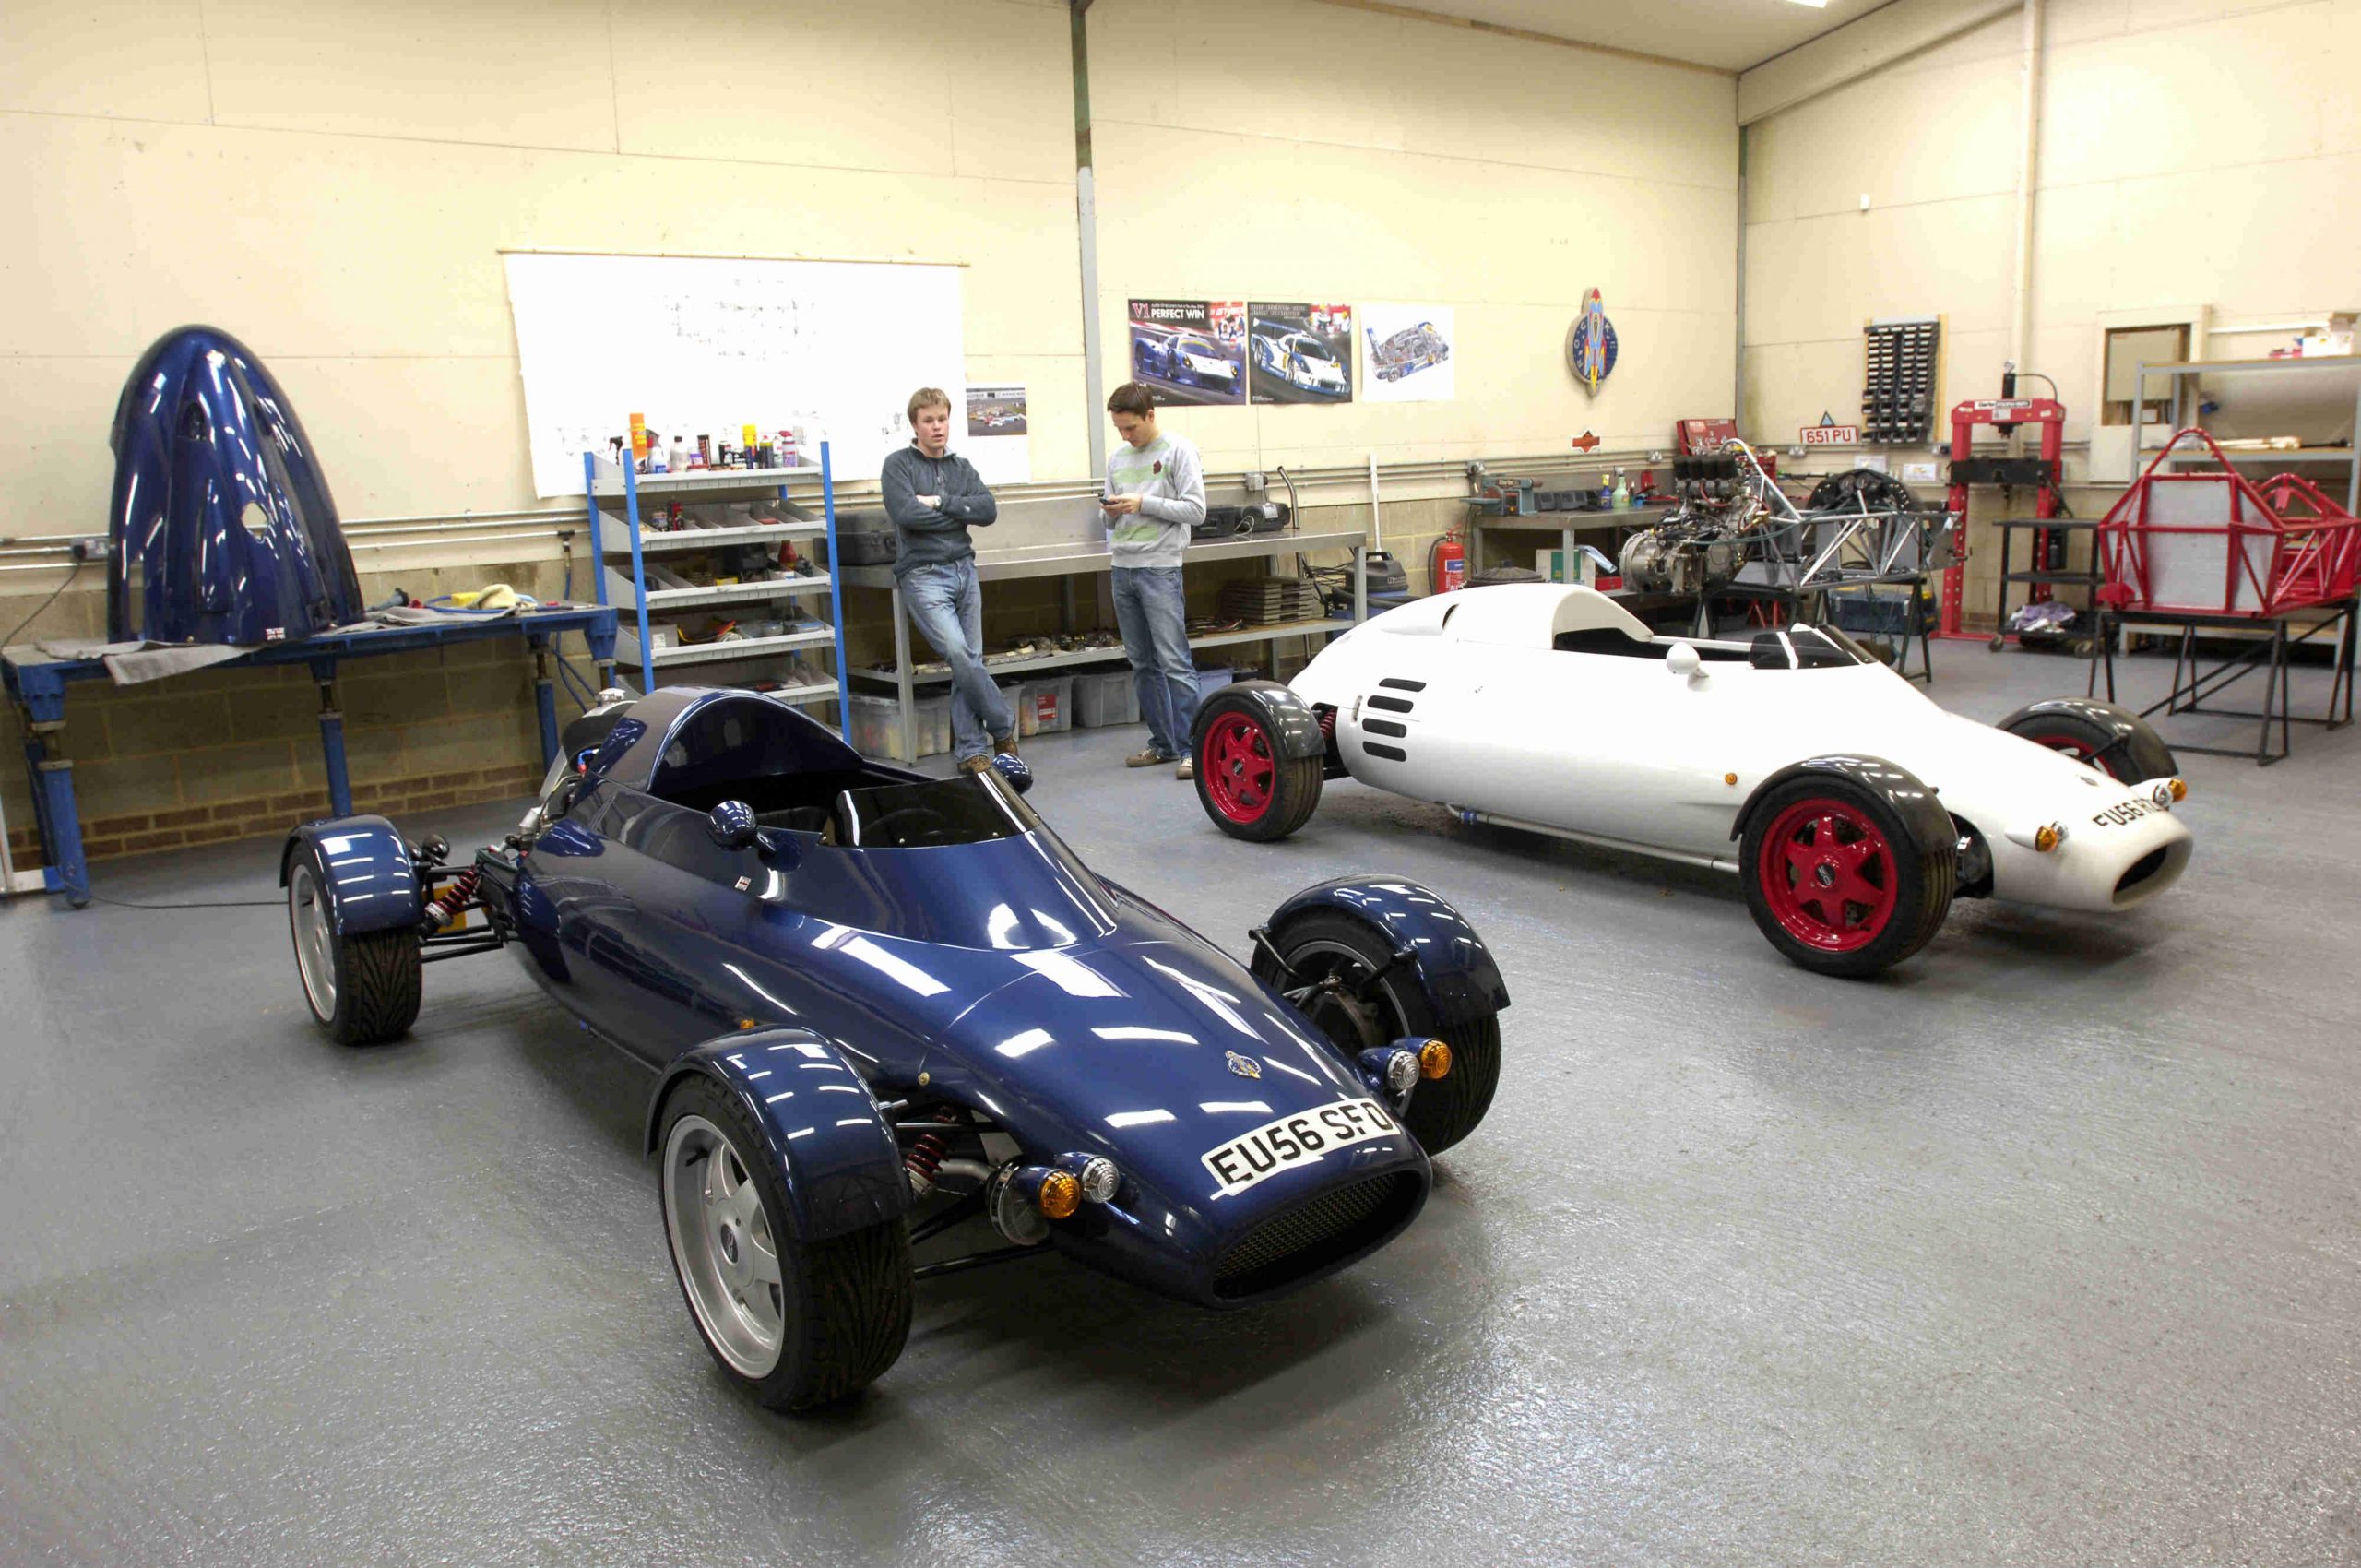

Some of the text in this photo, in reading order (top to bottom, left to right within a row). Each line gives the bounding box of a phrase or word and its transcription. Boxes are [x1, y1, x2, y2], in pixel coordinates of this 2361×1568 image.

[1132, 303, 1150, 319] V1
[1151, 308, 1184, 319] PERFECT
[1185, 309, 1204, 320] WIN
[1807, 428, 1851, 444] 651 PU
[1209, 1119, 1325, 1185] EU56
